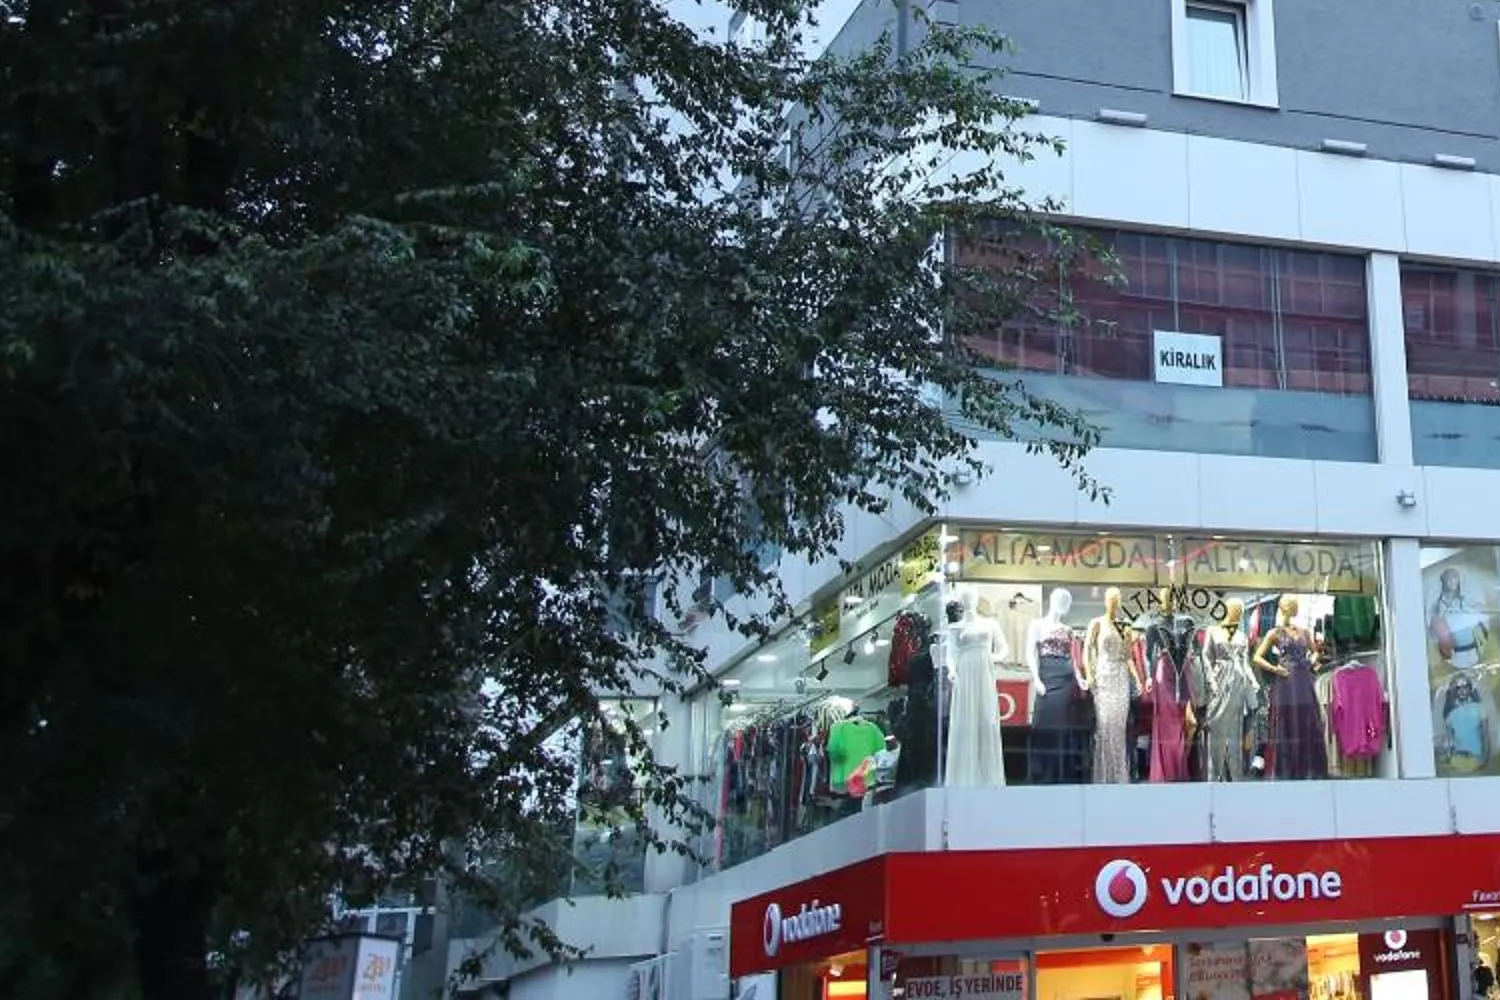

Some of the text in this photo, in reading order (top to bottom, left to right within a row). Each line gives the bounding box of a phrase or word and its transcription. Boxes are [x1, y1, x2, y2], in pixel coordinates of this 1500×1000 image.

[1160, 347, 1216, 371] KİRALIK
[975, 534, 1037, 568] ALTA
[1048, 537, 1148, 571] MODA
[1195, 546, 1357, 578] ALTA MODA
[1113, 584, 1238, 641] ALTA MODA
[1161, 863, 1342, 905] vodafone
[781, 900, 843, 944] vodafone
[1373, 949, 1421, 962] vodafone
[964, 973, 1024, 994] YERİNDE
